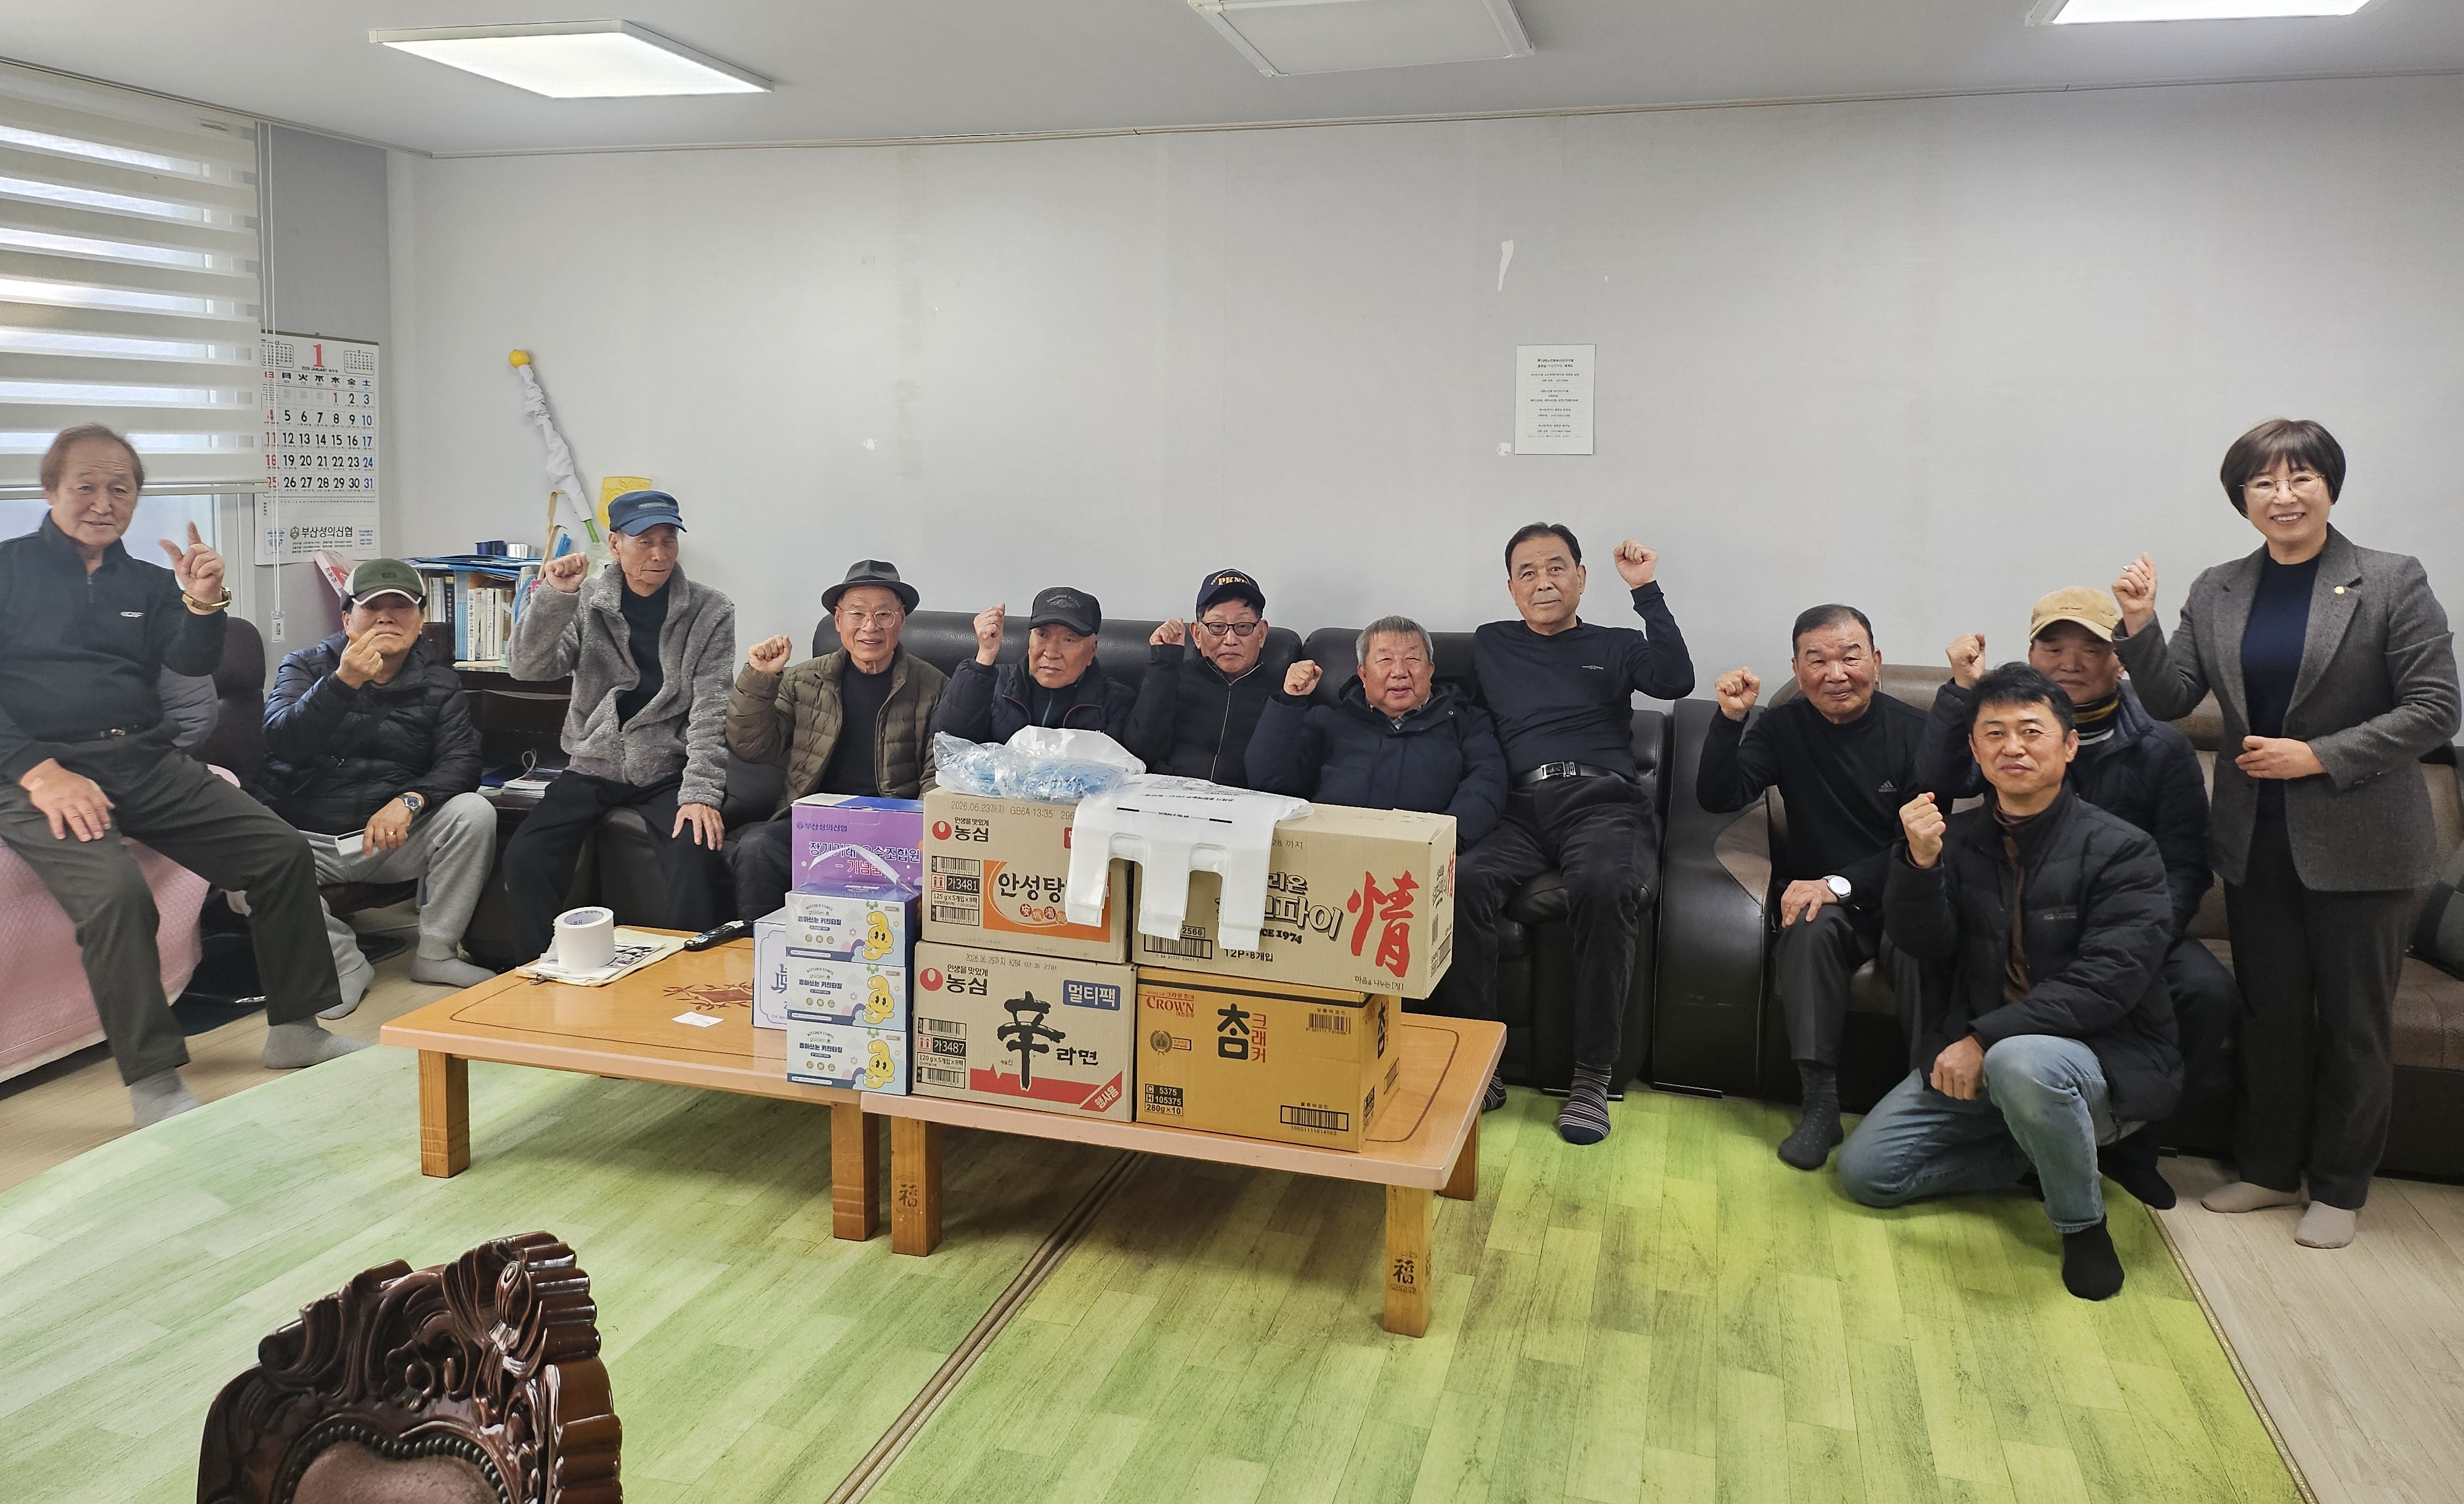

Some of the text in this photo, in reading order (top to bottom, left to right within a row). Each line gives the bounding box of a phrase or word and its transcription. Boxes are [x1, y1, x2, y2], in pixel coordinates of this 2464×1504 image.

[313, 344, 325, 367] 1
[333, 392, 338, 404] 1
[349, 393, 355, 404] 2
[364, 394, 370, 405] 3
[267, 409, 372, 426] 4 5 6 7 8 9 10
[266, 432, 373, 447] 11 12 13 14 15 16 17
[265, 454, 373, 468] 18 19 20 21 22 23 24
[267, 477, 373, 489] 25 26 27 28 29 30 31
[302, 526, 352, 538] 부산성의신협
[1047, 594, 1067, 603] PREMIUM
[951, 801, 1004, 813] 2026.06.23까지
[1010, 808, 1030, 816] GB6A
[1034, 808, 1053, 818] 13:35
[804, 823, 847, 832] 부산성의신협
[955, 817, 989, 826] 인생을 맛있게
[955, 825, 989, 842] 농심
[809, 842, 856, 859] 장기거래
[1286, 840, 1303, 850] 까지
[947, 878, 978, 891] 가3481
[998, 872, 1068, 903] 안성탕
[1268, 872, 1308, 895] 리온
[1264, 896, 1344, 941] 파이
[1347, 870, 1419, 978] 情
[1182, 927, 1202, 936] 2566
[1276, 929, 1303, 944] 1974
[965, 954, 1005, 965] 2026.06.29까지
[947, 964, 988, 977] 인생을 맛있게
[946, 974, 987, 996] 농심
[1355, 976, 1372, 985] 마음을
[1068, 984, 1116, 1007] 멀티팩
[1146, 996, 1194, 1013] CROWN
[997, 991, 1066, 1090] 辛
[1251, 1013, 1267, 1063] 크래커
[934, 1039, 965, 1054] 가3487
[1056, 1047, 1098, 1066] 라면
[1094, 1085, 1119, 1109] 행사용
[1159, 1087, 1177, 1096] 5375
[1155, 1095, 1181, 1105] 105375
[899, 1184, 918, 1207] 福
[1393, 1259, 1415, 1284] 福
